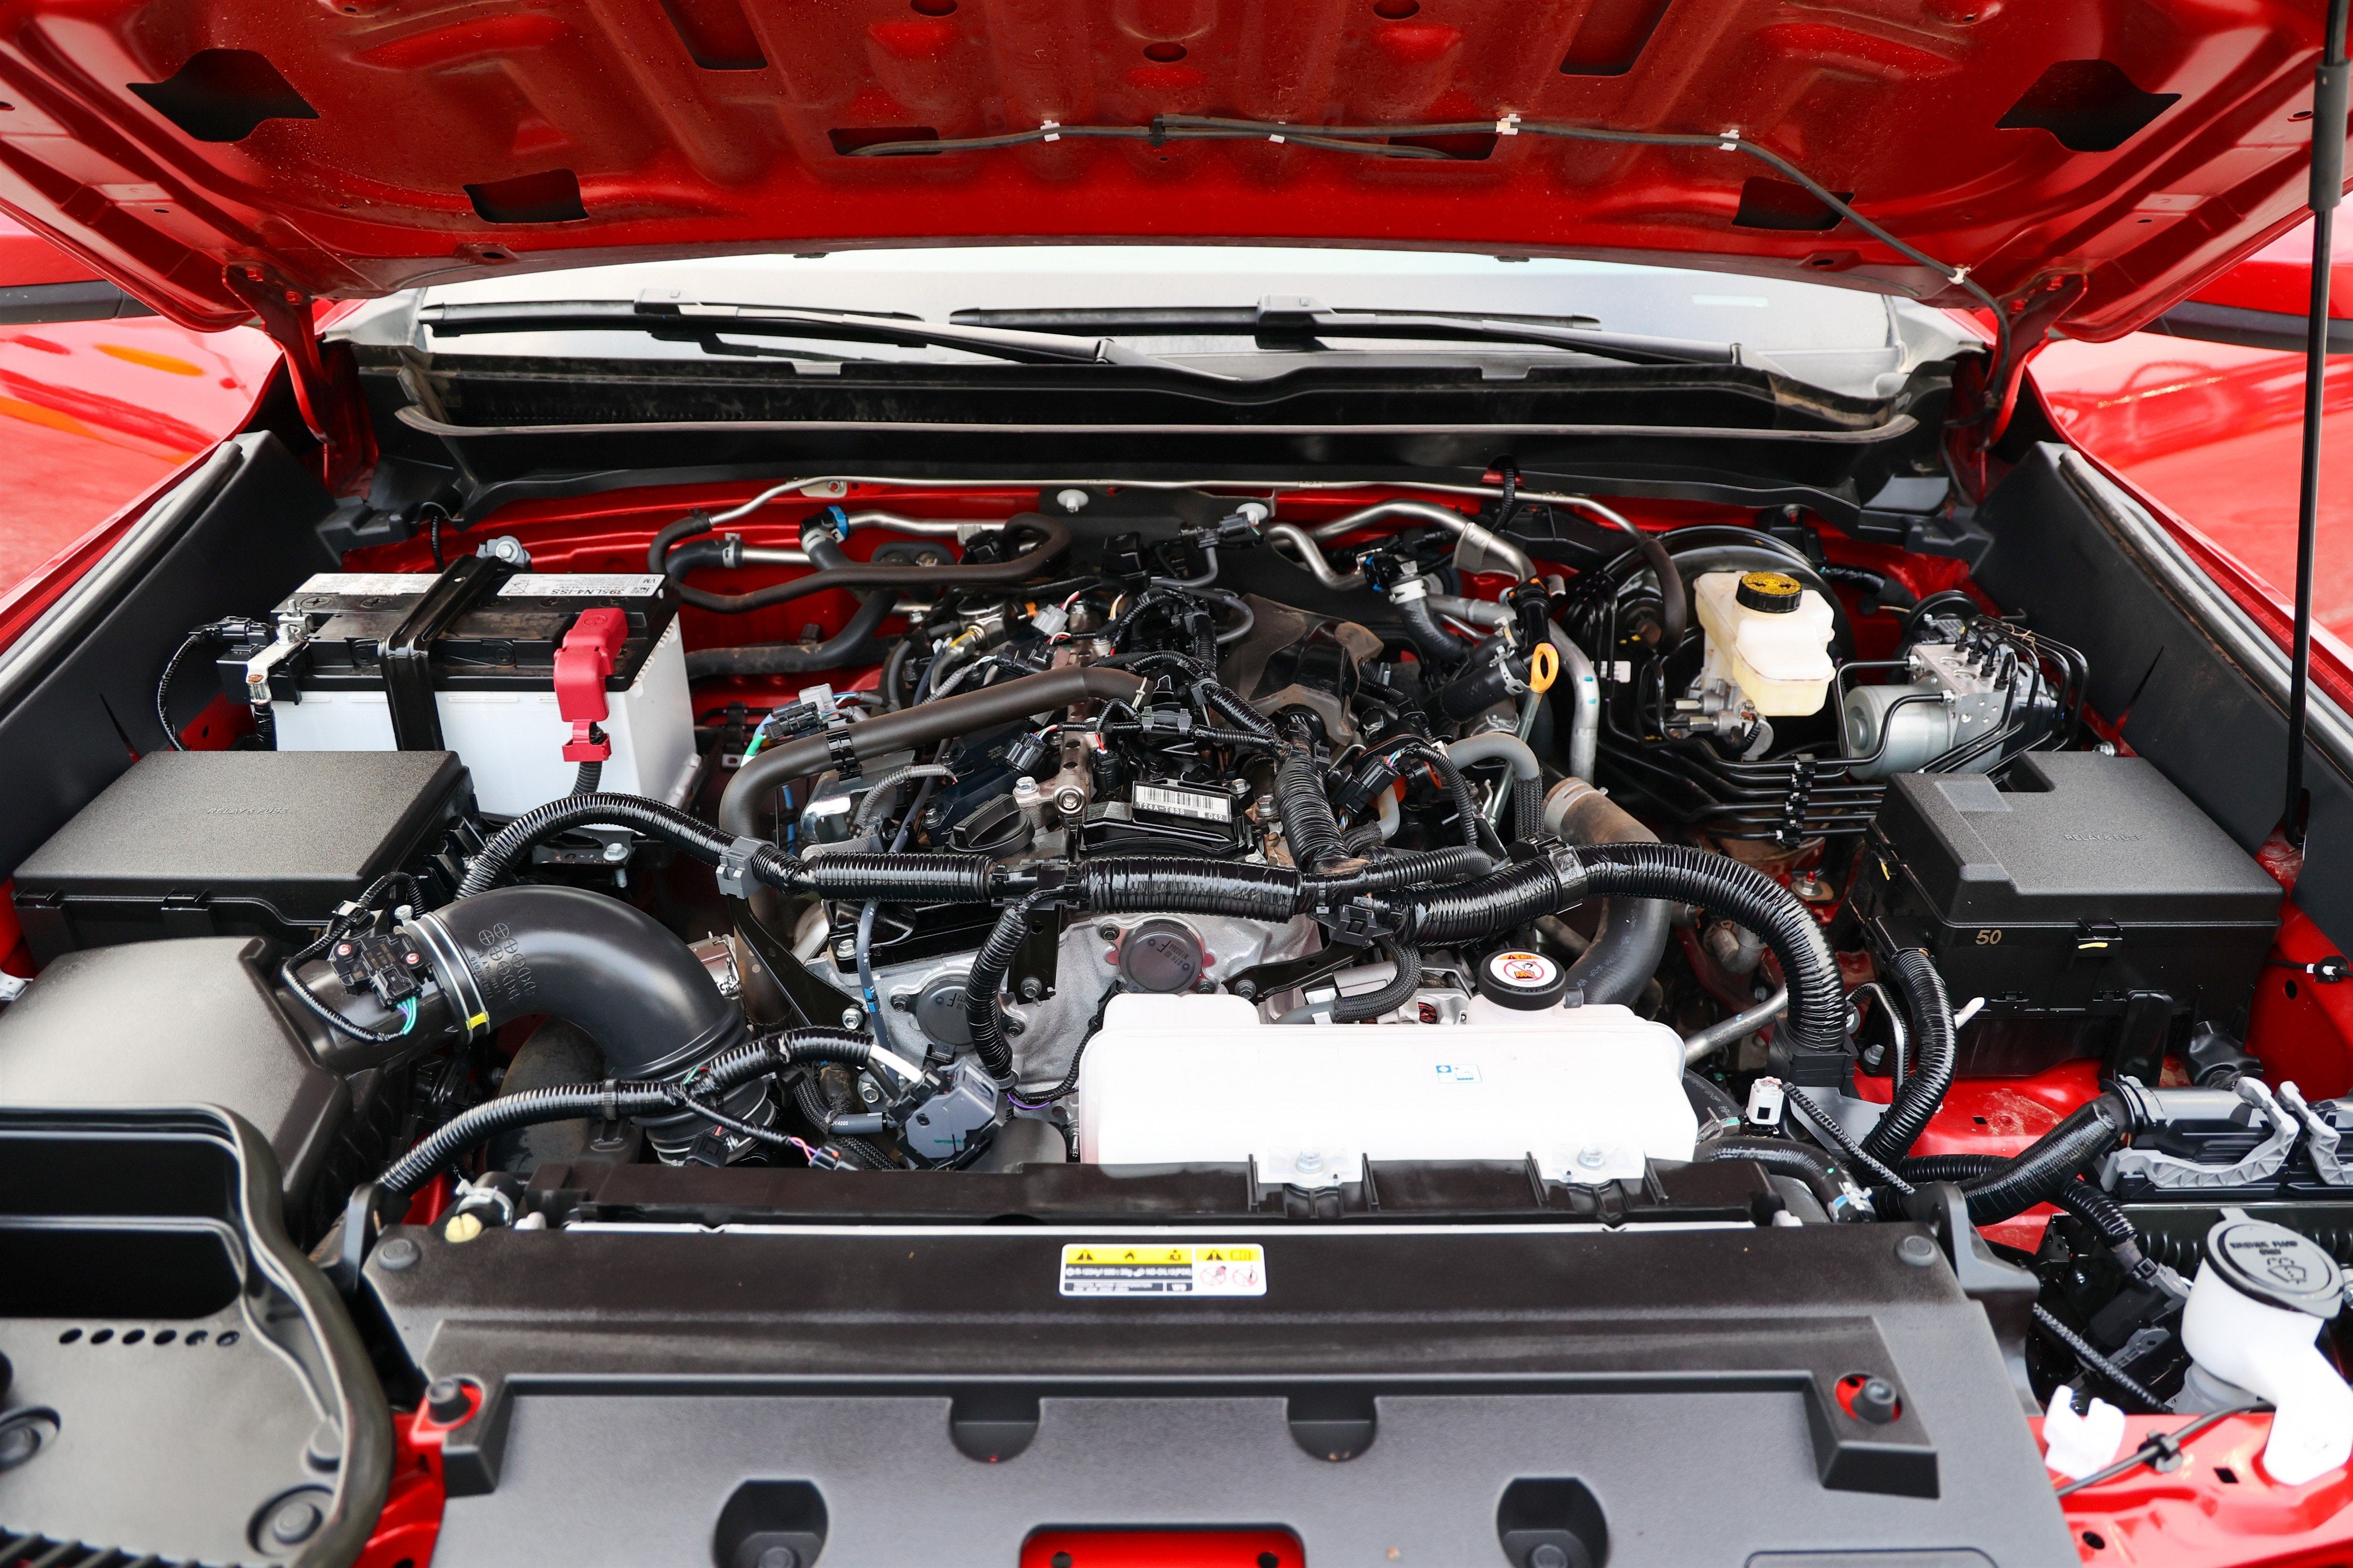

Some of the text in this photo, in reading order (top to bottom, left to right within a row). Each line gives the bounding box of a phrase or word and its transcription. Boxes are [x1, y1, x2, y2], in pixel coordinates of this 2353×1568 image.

[1976, 929, 2002, 945] 50
[1156, 940, 1171, 953] F
[947, 993, 957, 1007] F
